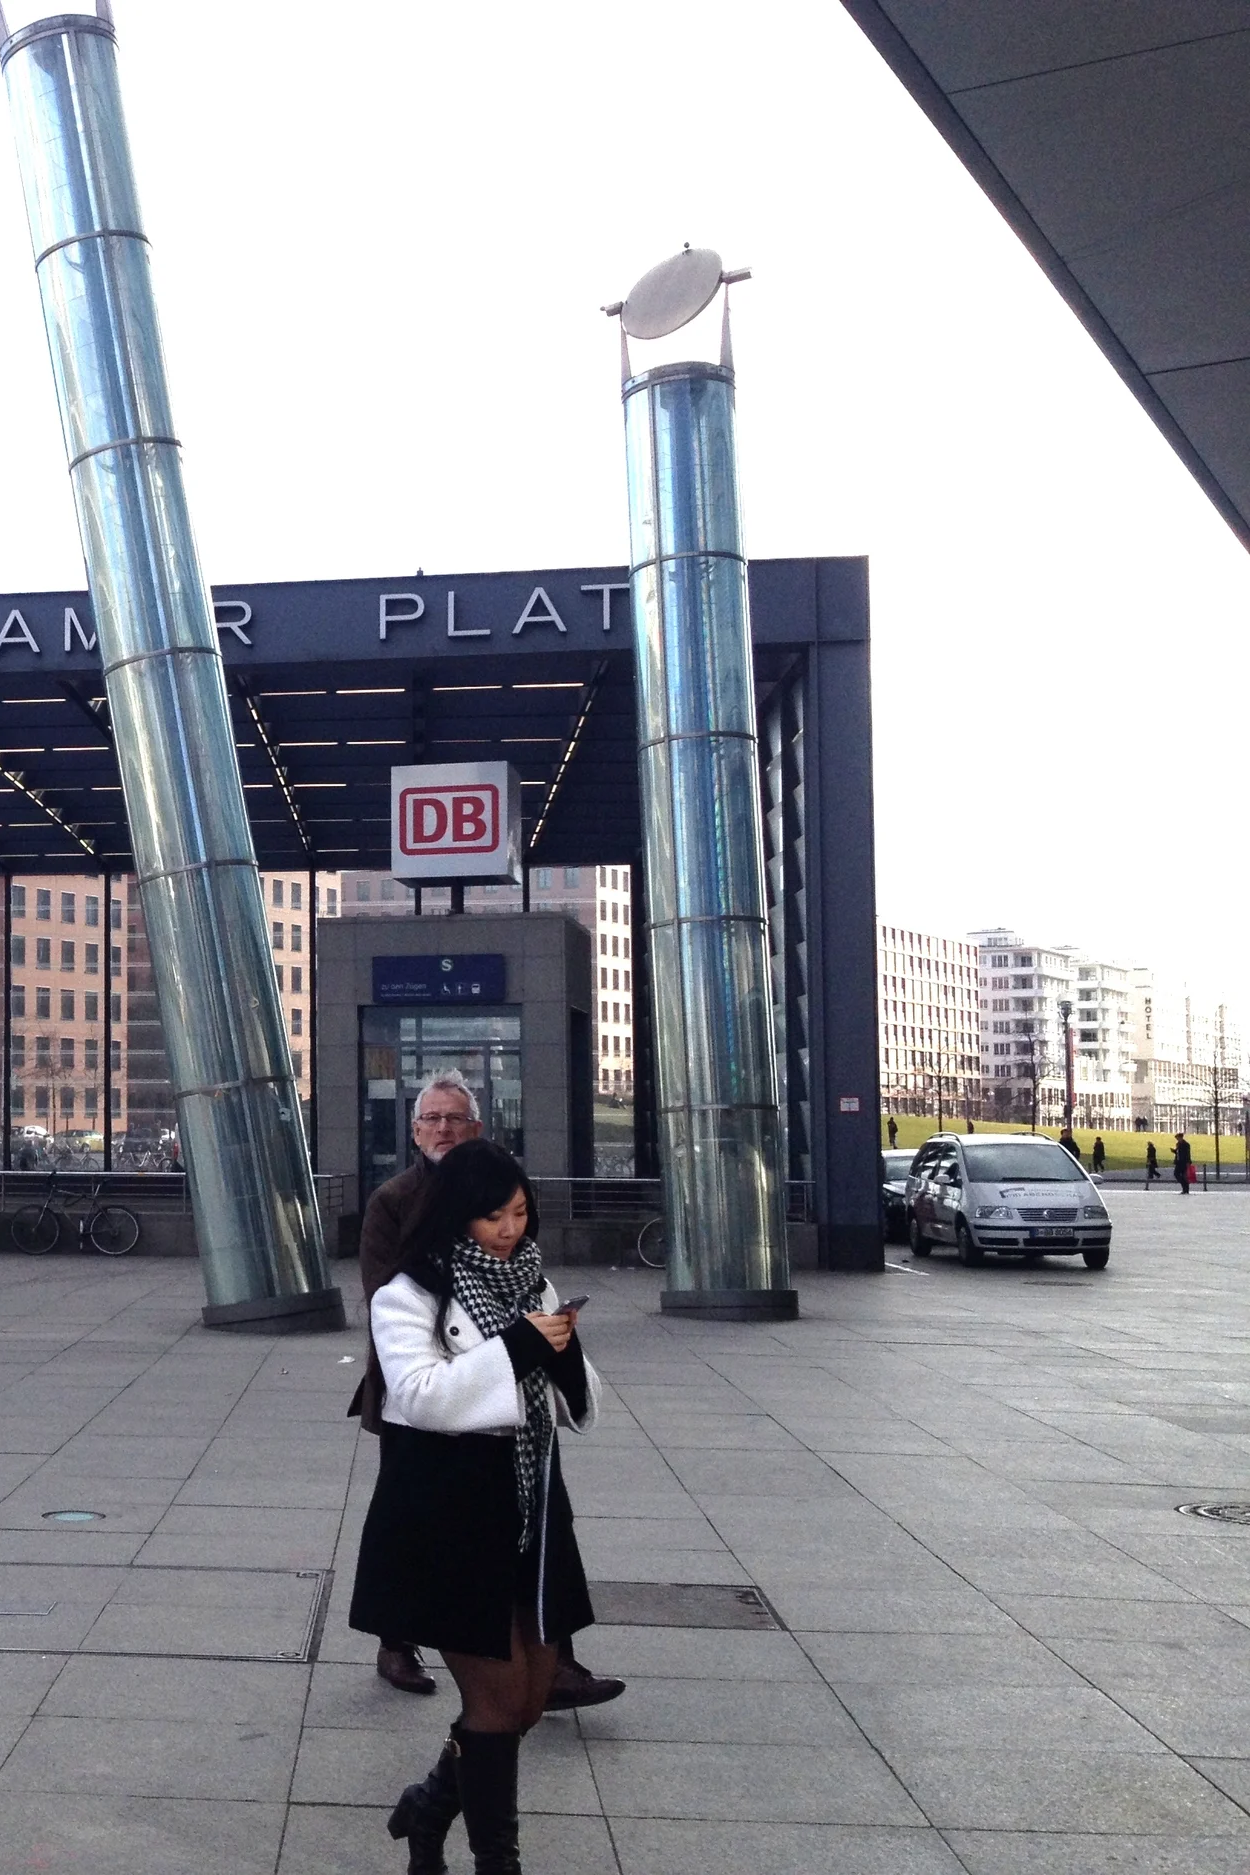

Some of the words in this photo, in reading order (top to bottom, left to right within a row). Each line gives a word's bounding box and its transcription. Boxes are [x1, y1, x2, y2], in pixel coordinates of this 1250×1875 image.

[378, 583, 631, 640] PLAT
[412, 796, 488, 844] DB
[441, 959, 453, 972] S
[1144, 997, 1152, 1040] HOTEL
